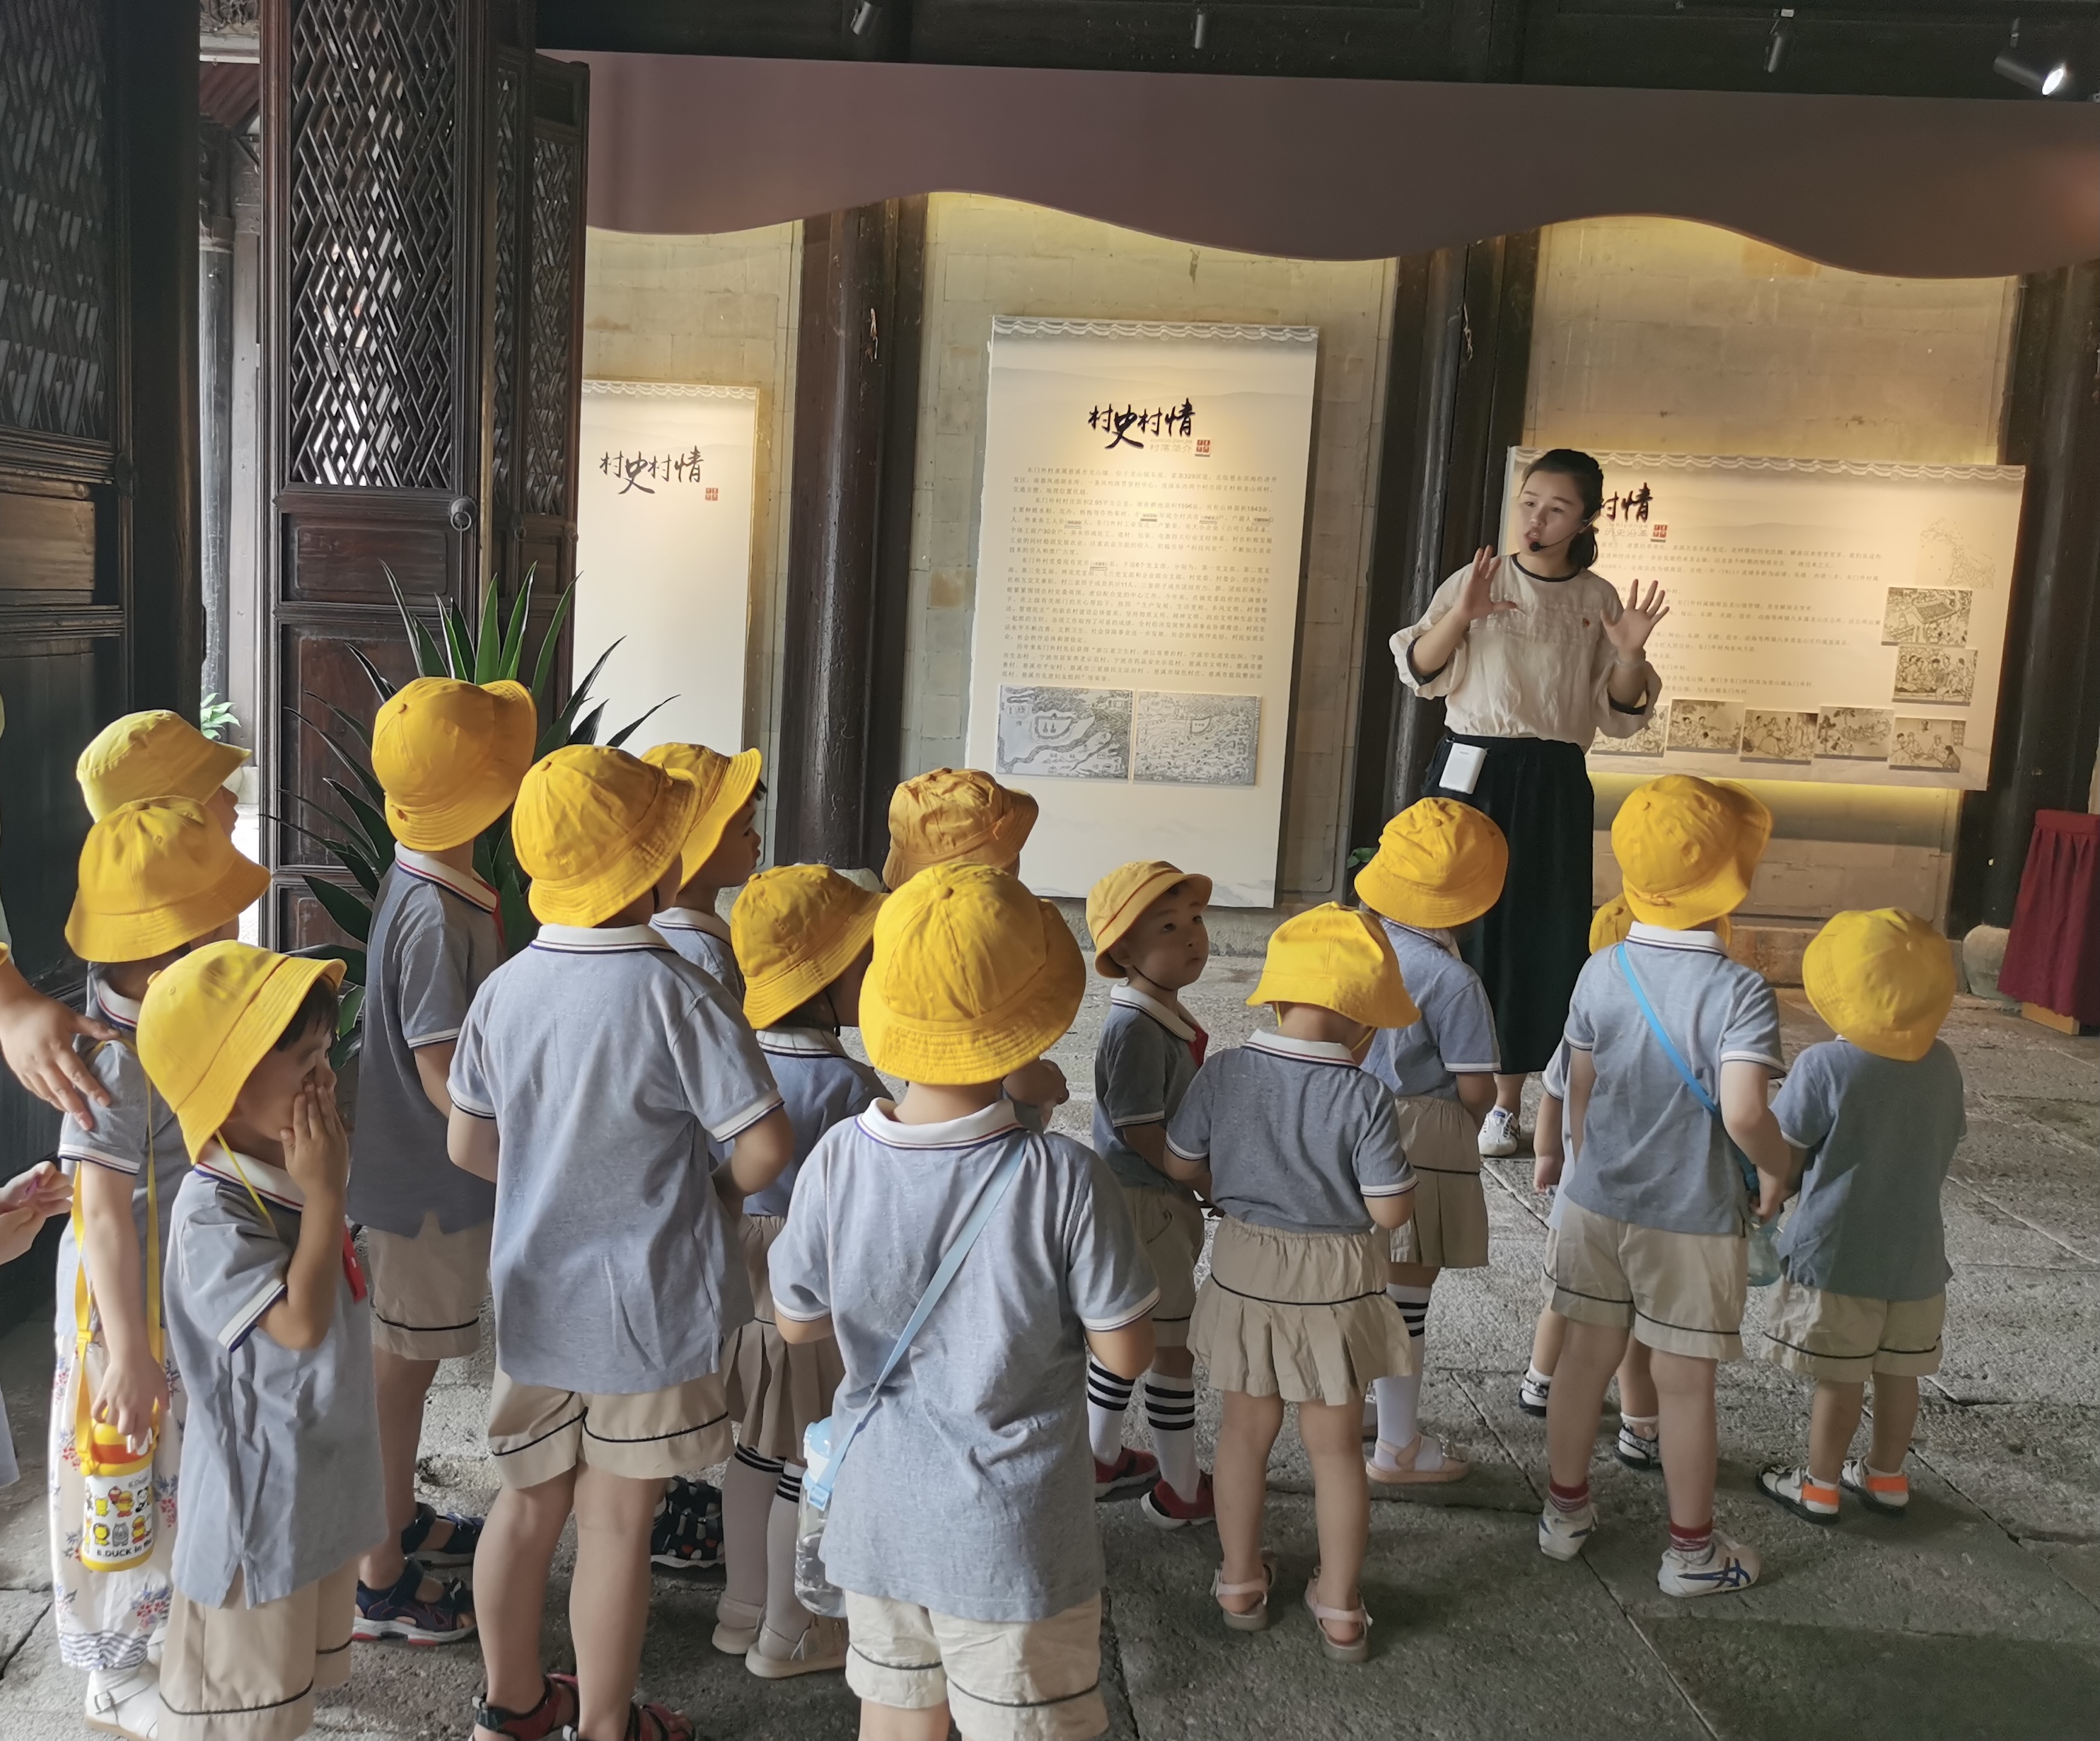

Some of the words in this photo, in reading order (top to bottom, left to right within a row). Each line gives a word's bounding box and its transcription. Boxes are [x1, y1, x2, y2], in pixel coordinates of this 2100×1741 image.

[1088, 398, 1195, 449] 村史村情
[1149, 444, 1192, 453] 村落简介
[600, 446, 704, 494] 村史村情
[1604, 528, 1647, 538] 历史沿革
